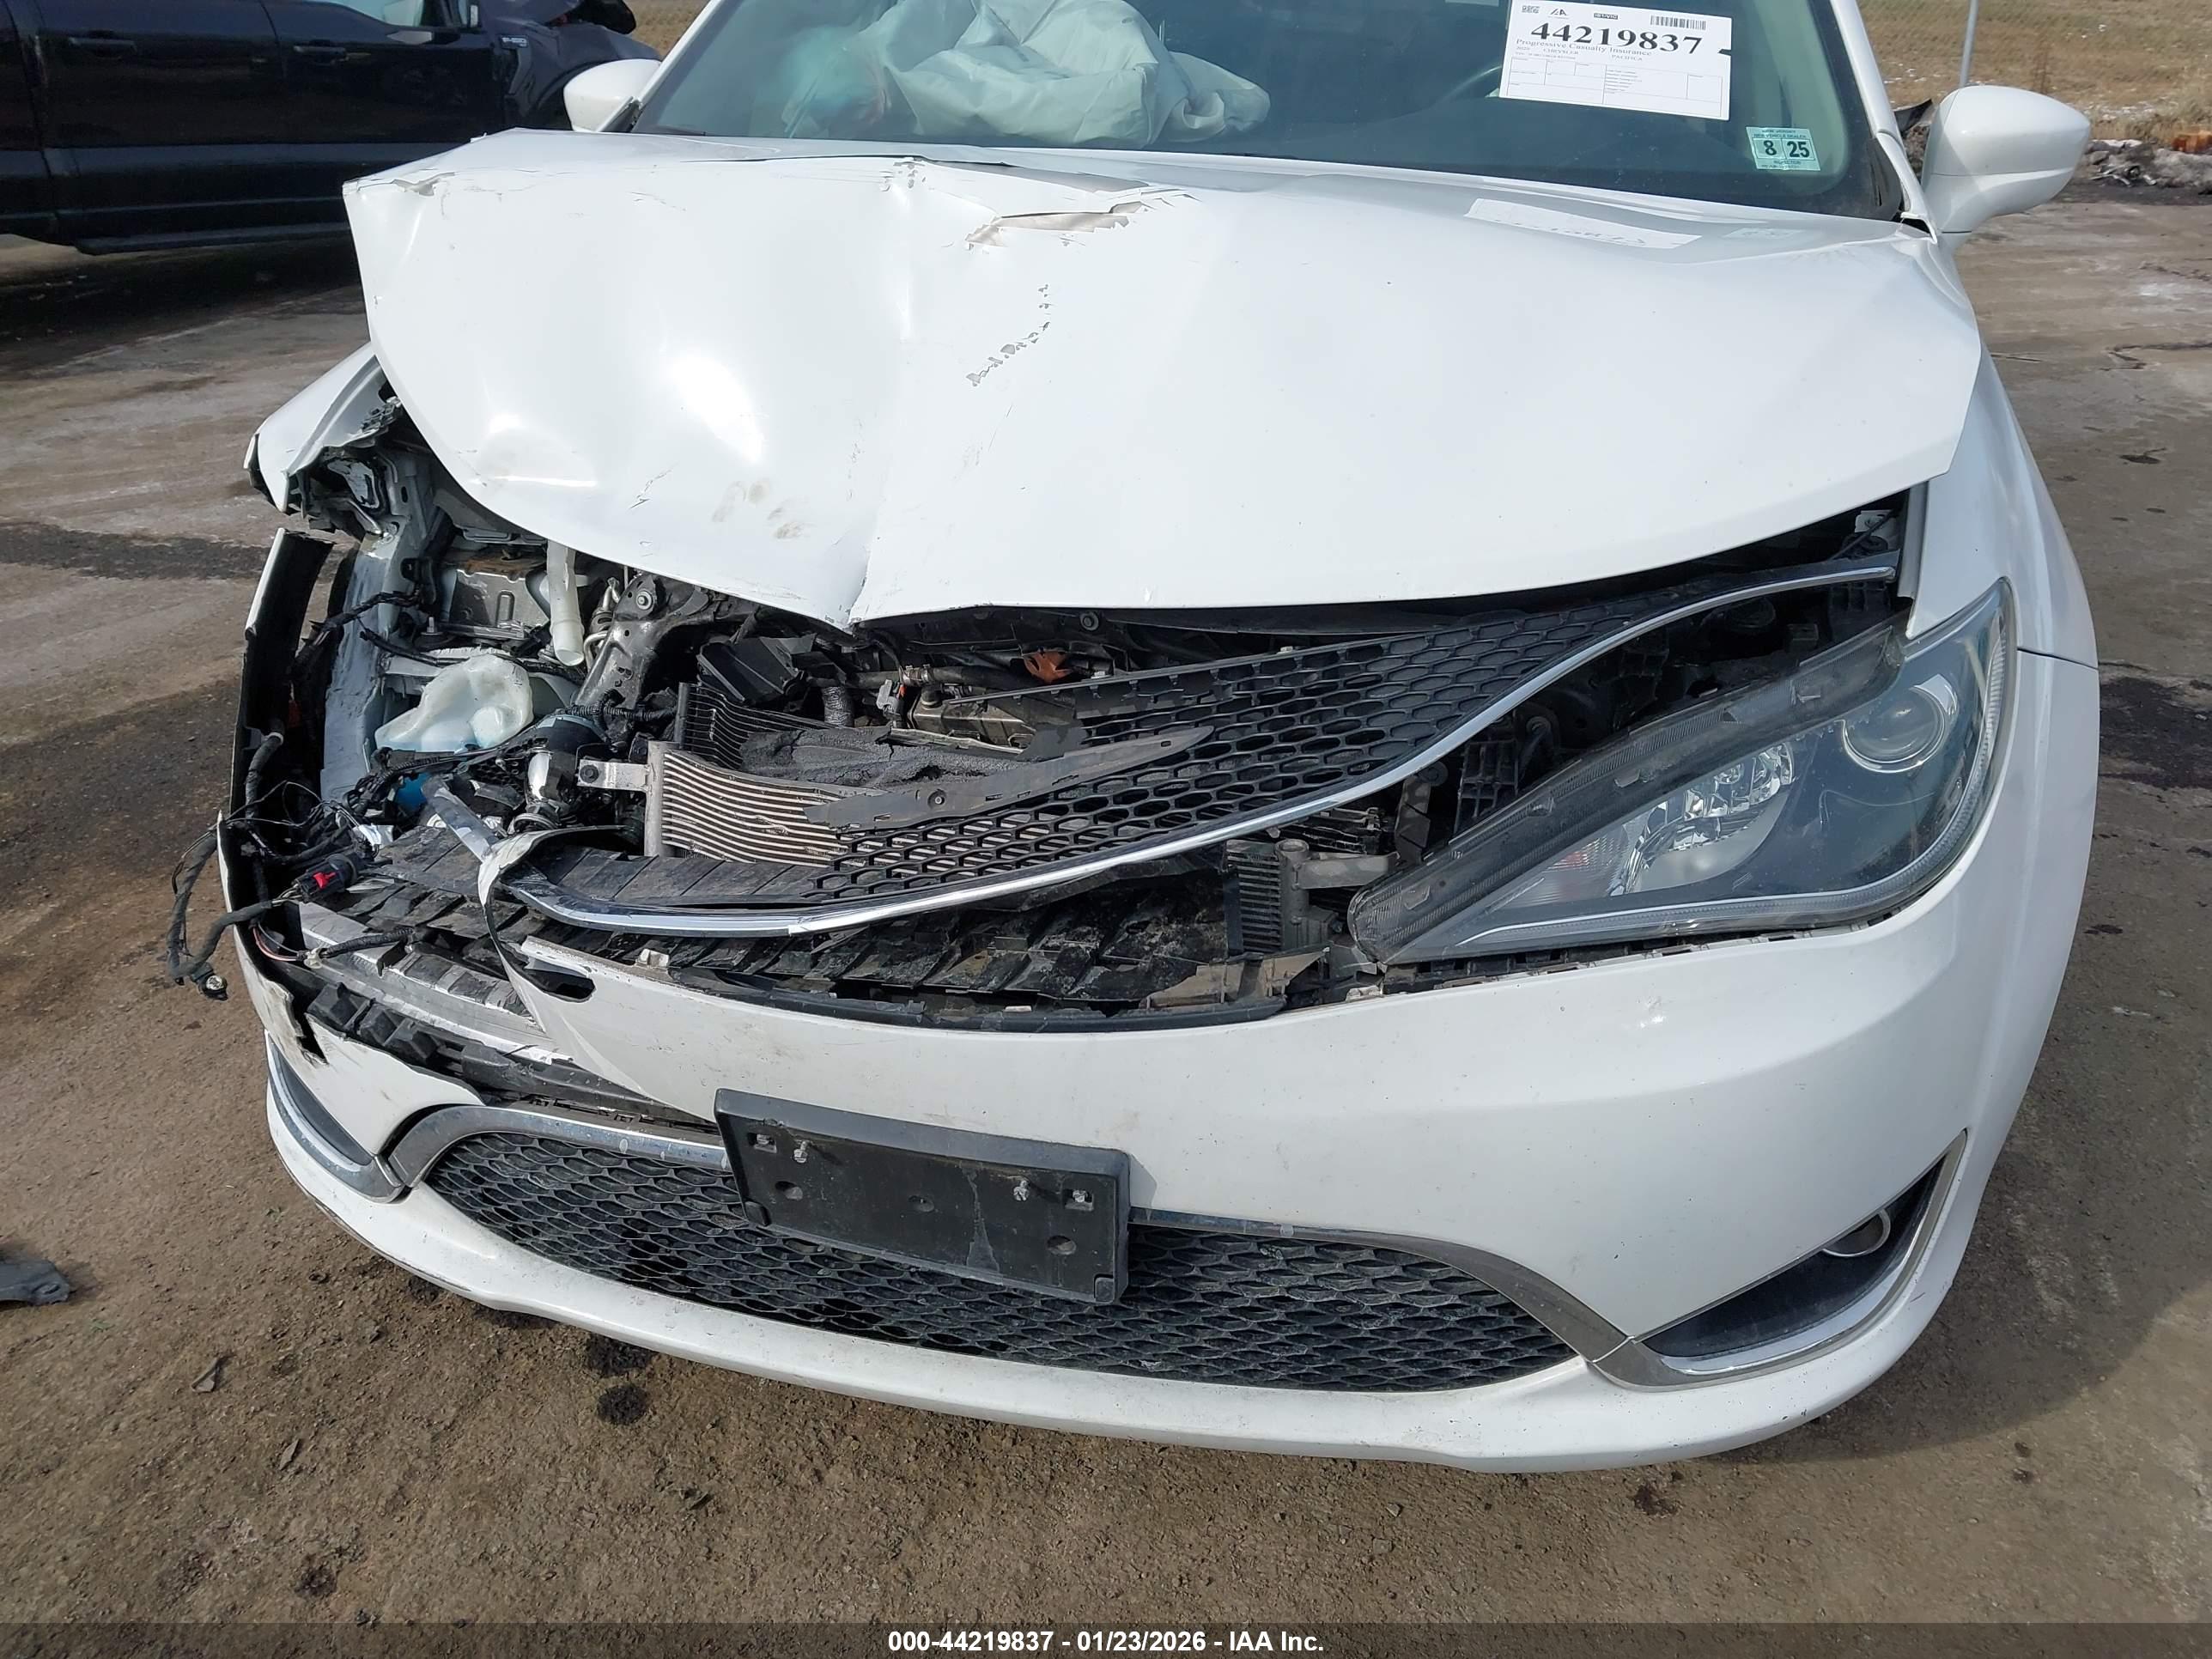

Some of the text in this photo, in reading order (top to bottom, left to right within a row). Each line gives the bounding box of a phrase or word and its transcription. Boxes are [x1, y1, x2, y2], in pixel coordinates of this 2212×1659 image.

[1530, 22, 1704, 54] 44219837
[1516, 39, 1653, 56] Progressive Casualty Insurance
[1763, 140, 1810, 158] 8 25
